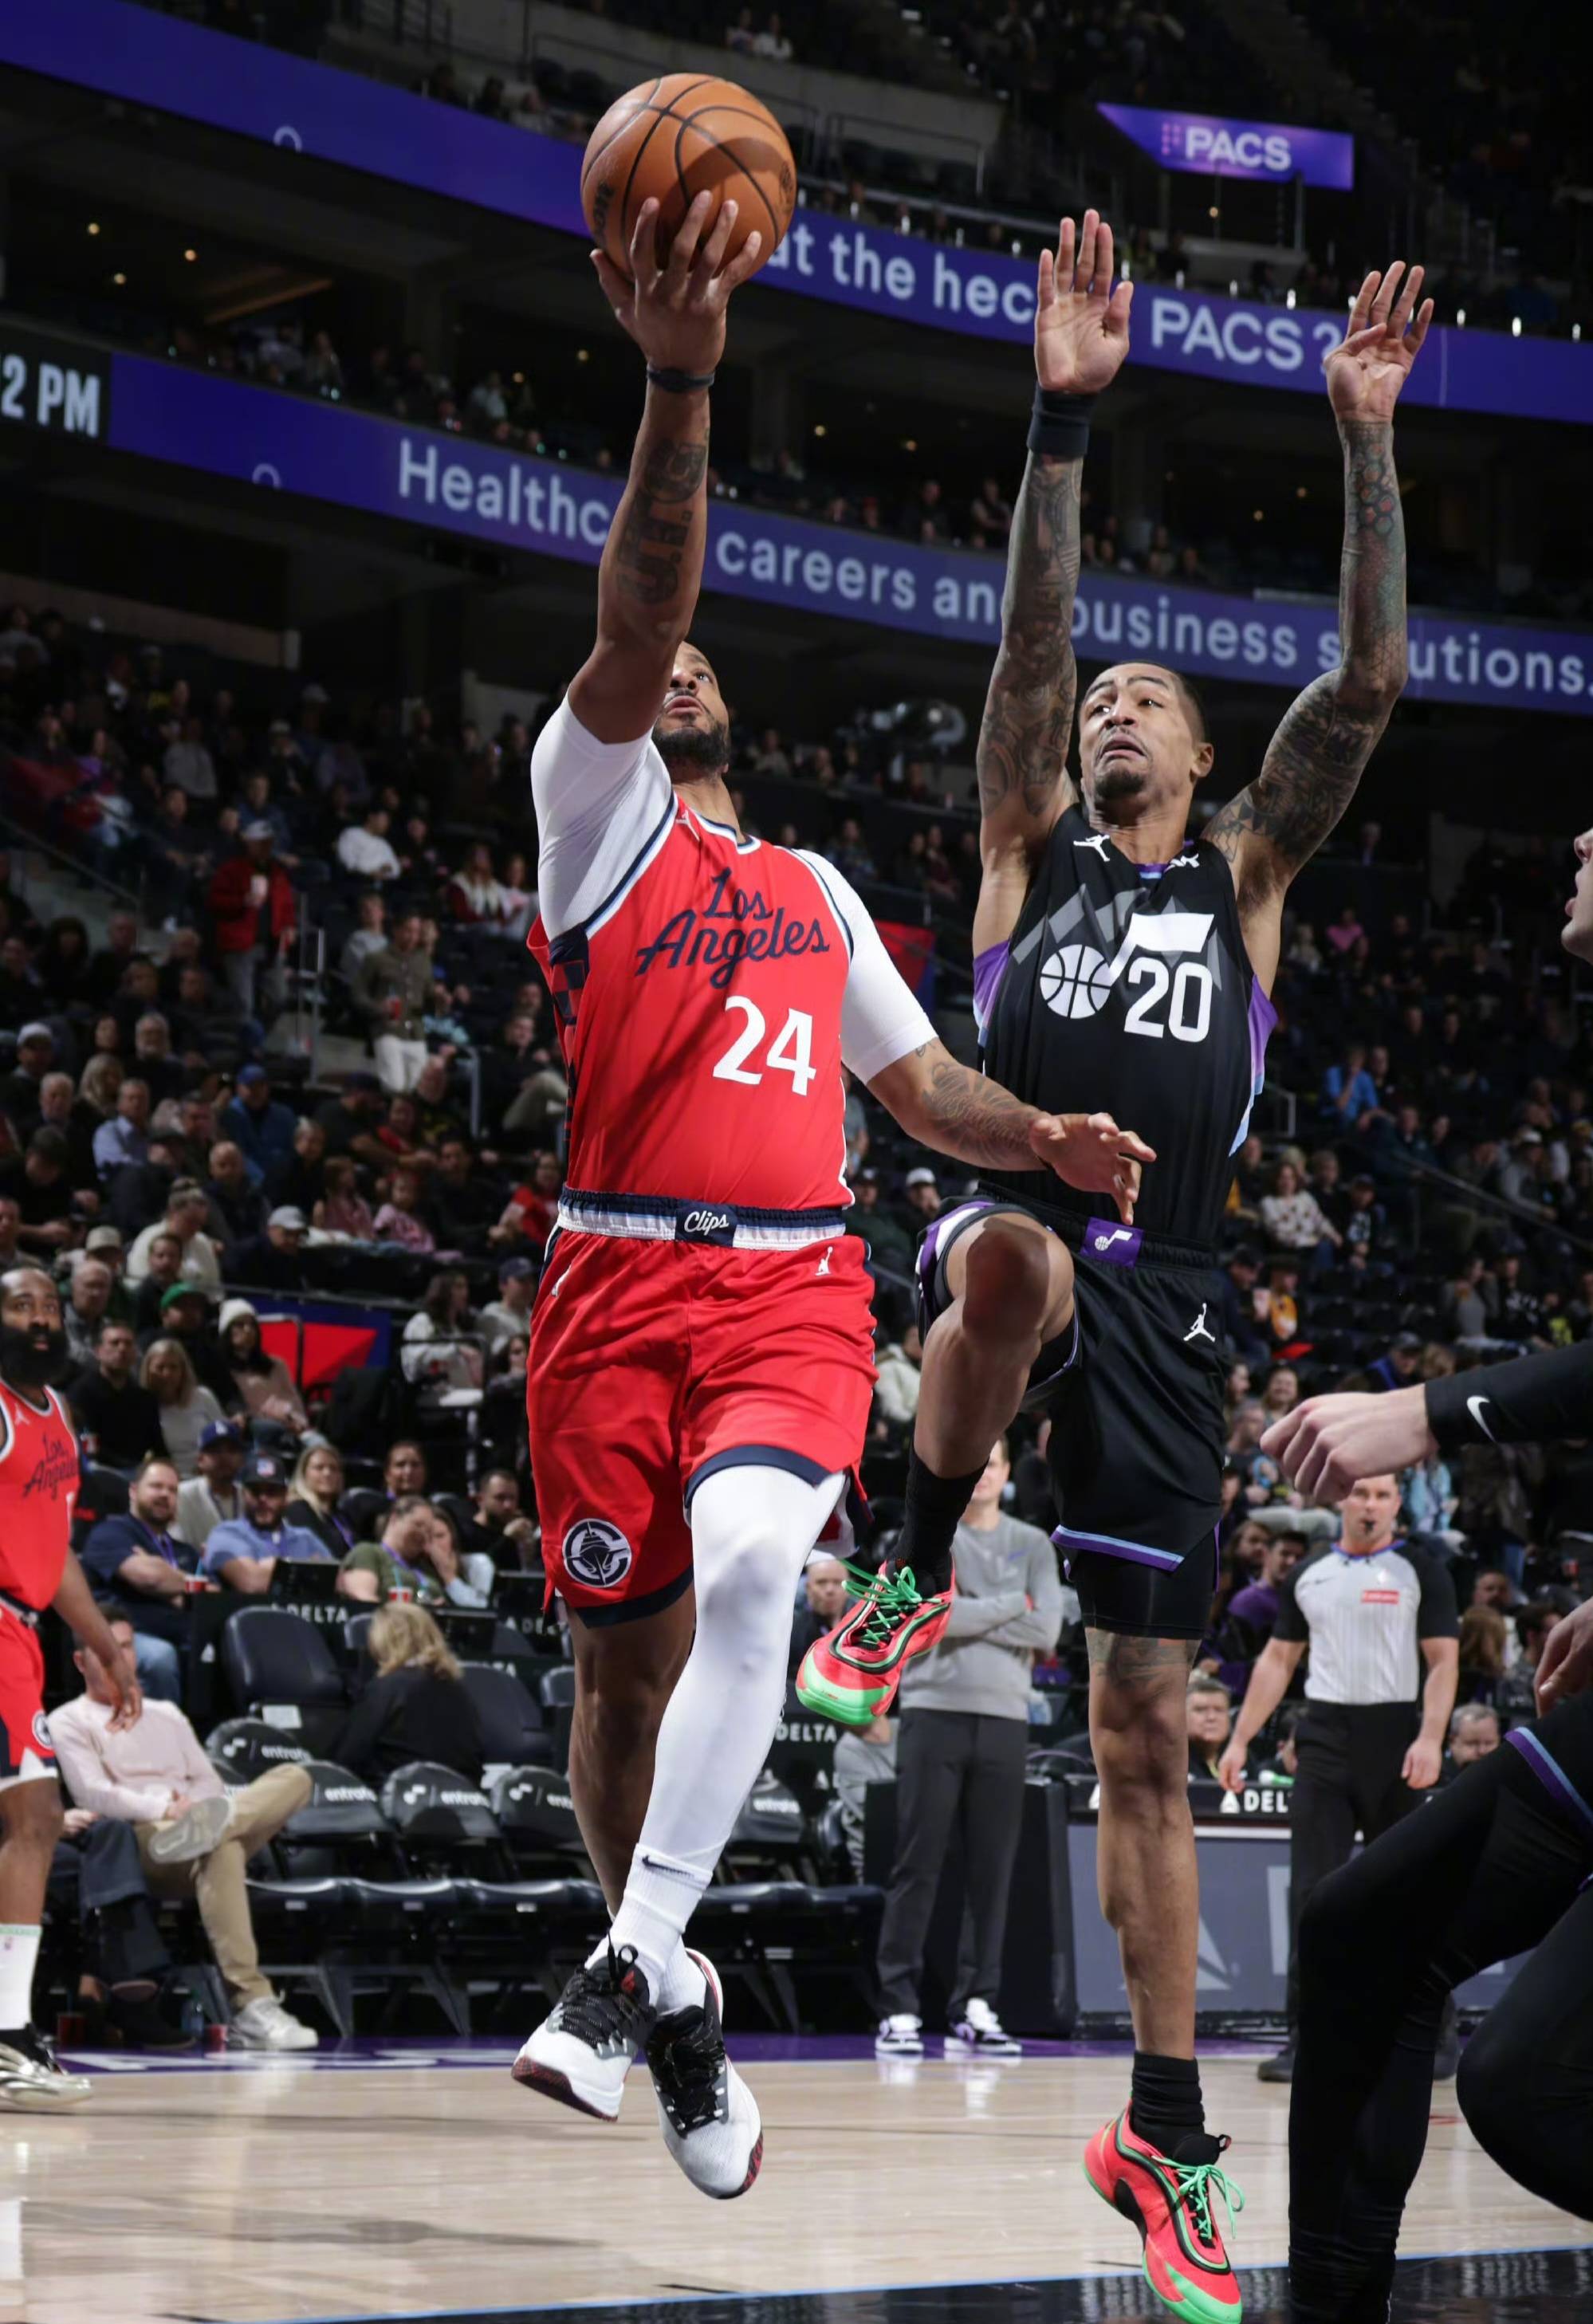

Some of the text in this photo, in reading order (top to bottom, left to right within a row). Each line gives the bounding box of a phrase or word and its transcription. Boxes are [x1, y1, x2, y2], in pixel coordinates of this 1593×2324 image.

[1185, 126, 1292, 171] PACS
[829, 230, 916, 301] the
[934, 250, 1035, 324] hec
[1, 353, 100, 438] 2 PM
[399, 436, 612, 546] Healthc
[716, 530, 917, 611] careers
[931, 576, 997, 625] an
[702, 866, 774, 922] Los
[634, 906, 830, 989] Angeles
[1123, 956, 1213, 1043] 20
[712, 995, 816, 1096] 24
[683, 1209, 730, 1237] Clips
[775, 1722, 837, 1743] DELTA
[1244, 1788, 1292, 1814] DEL
